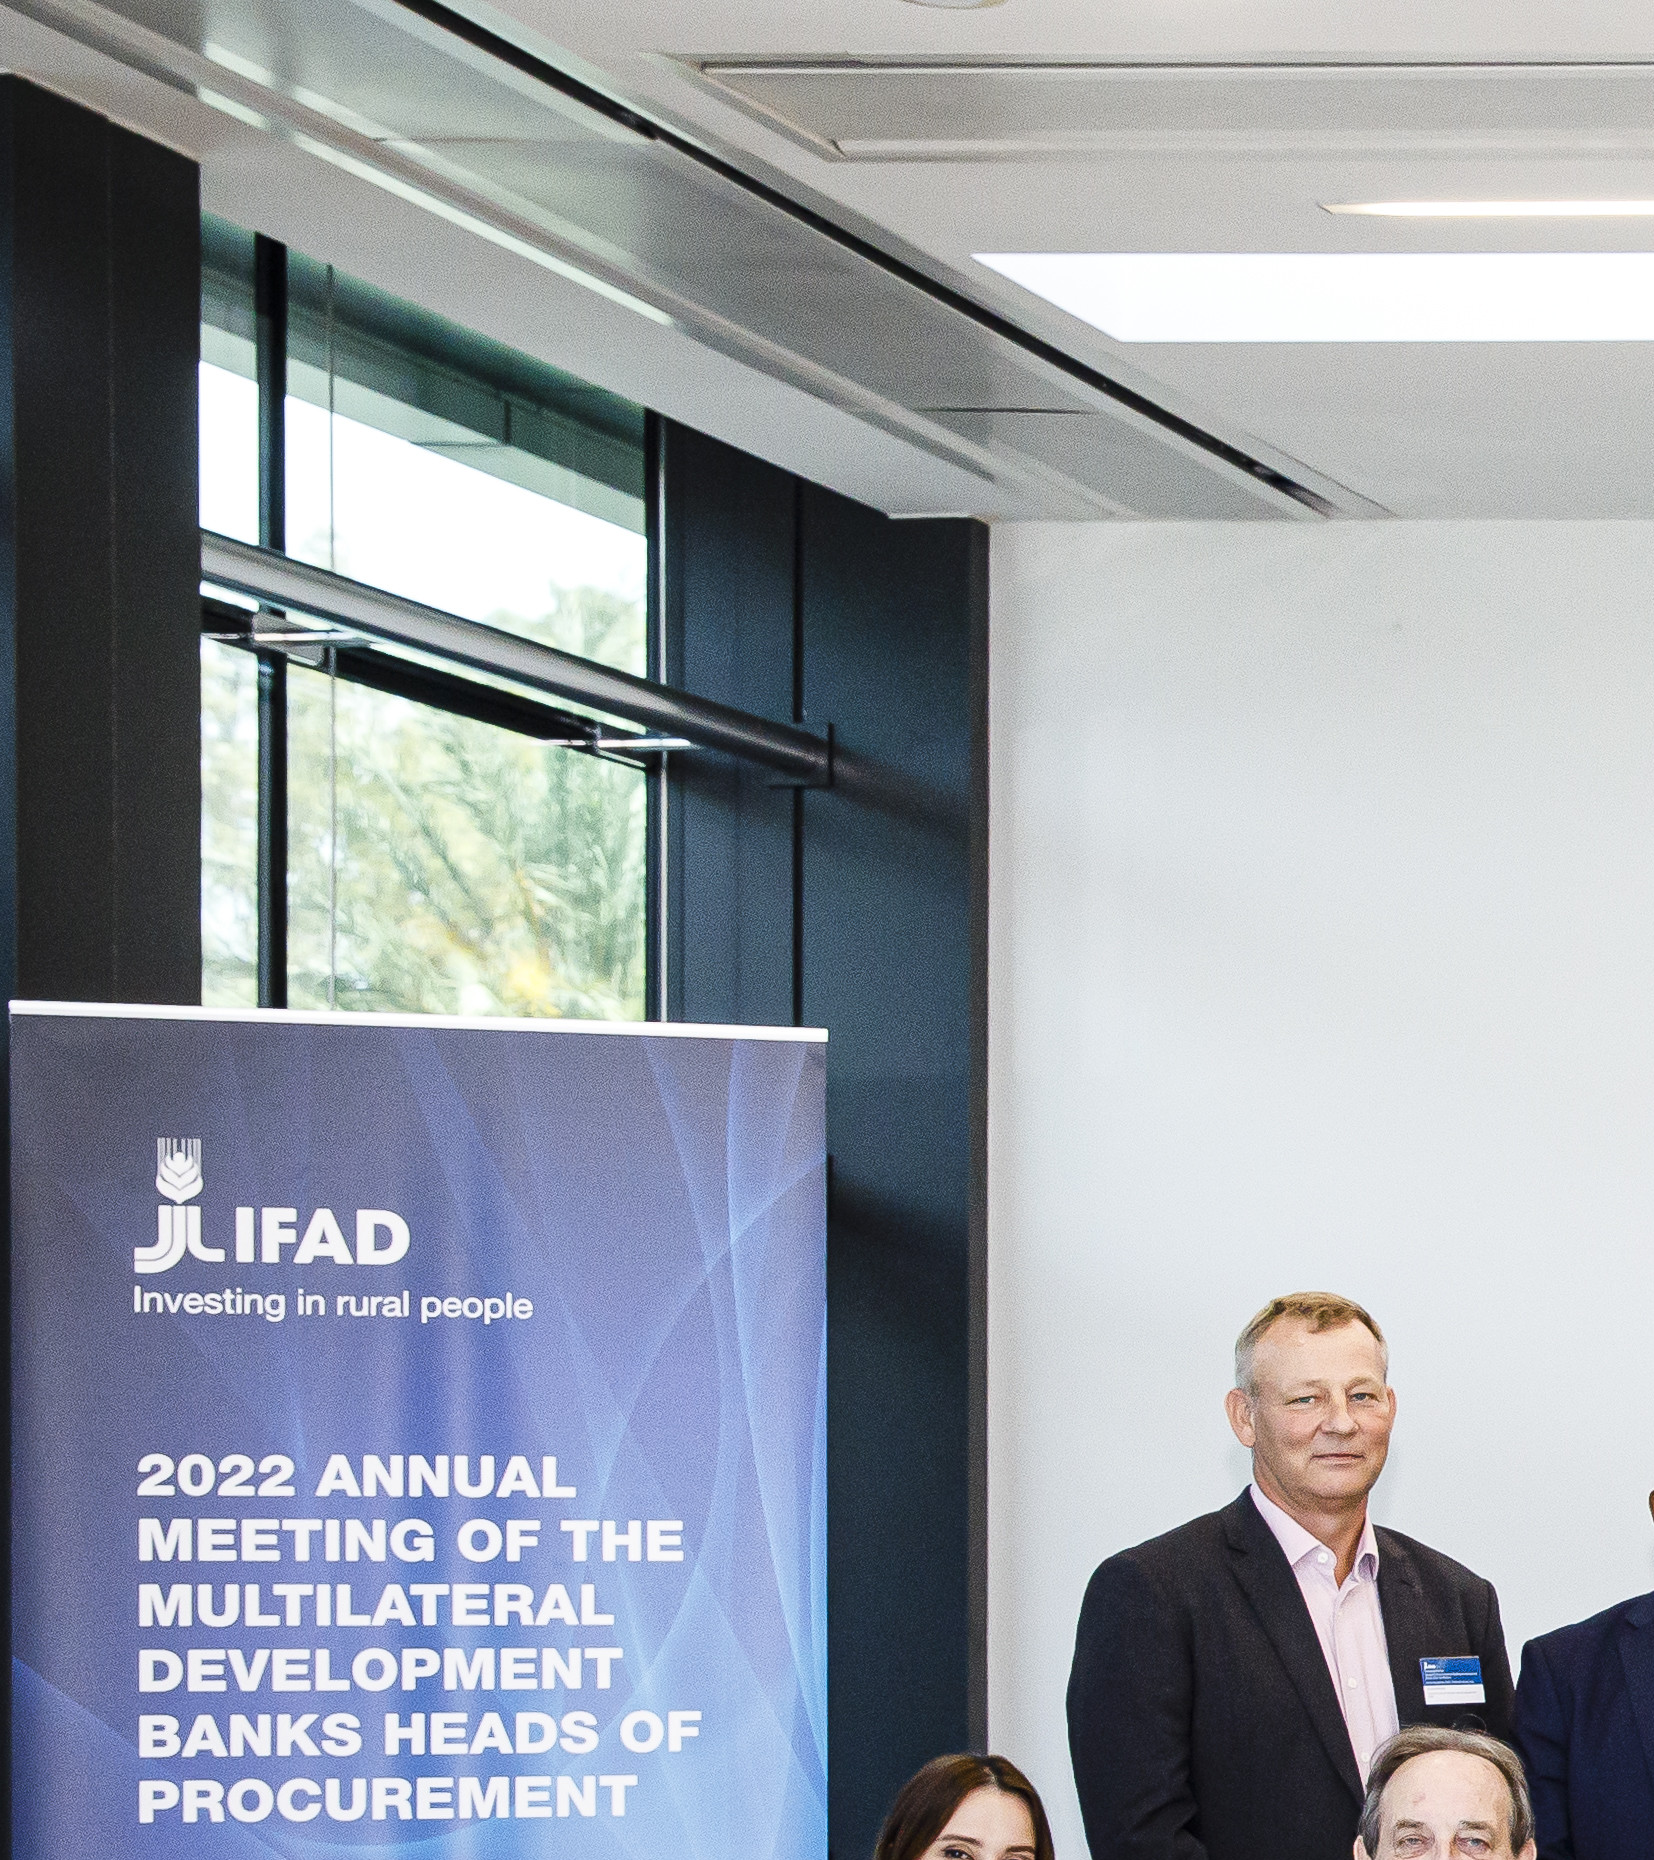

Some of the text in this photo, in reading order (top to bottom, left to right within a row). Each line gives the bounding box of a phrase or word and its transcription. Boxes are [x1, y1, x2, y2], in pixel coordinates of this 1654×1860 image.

[235, 1207, 410, 1266] IFAD
[133, 1285, 534, 1325] Investing in rural people
[137, 1453, 577, 1499] 2022 ANNUAL
[138, 1518, 684, 1563] MEETING OF THE
[138, 1583, 615, 1629] MULTILATERAL
[138, 1647, 623, 1693] DEVELOPMENT
[138, 1709, 702, 1758] BANKS HEADS OF
[138, 1775, 638, 1826] PROCUREMENT
